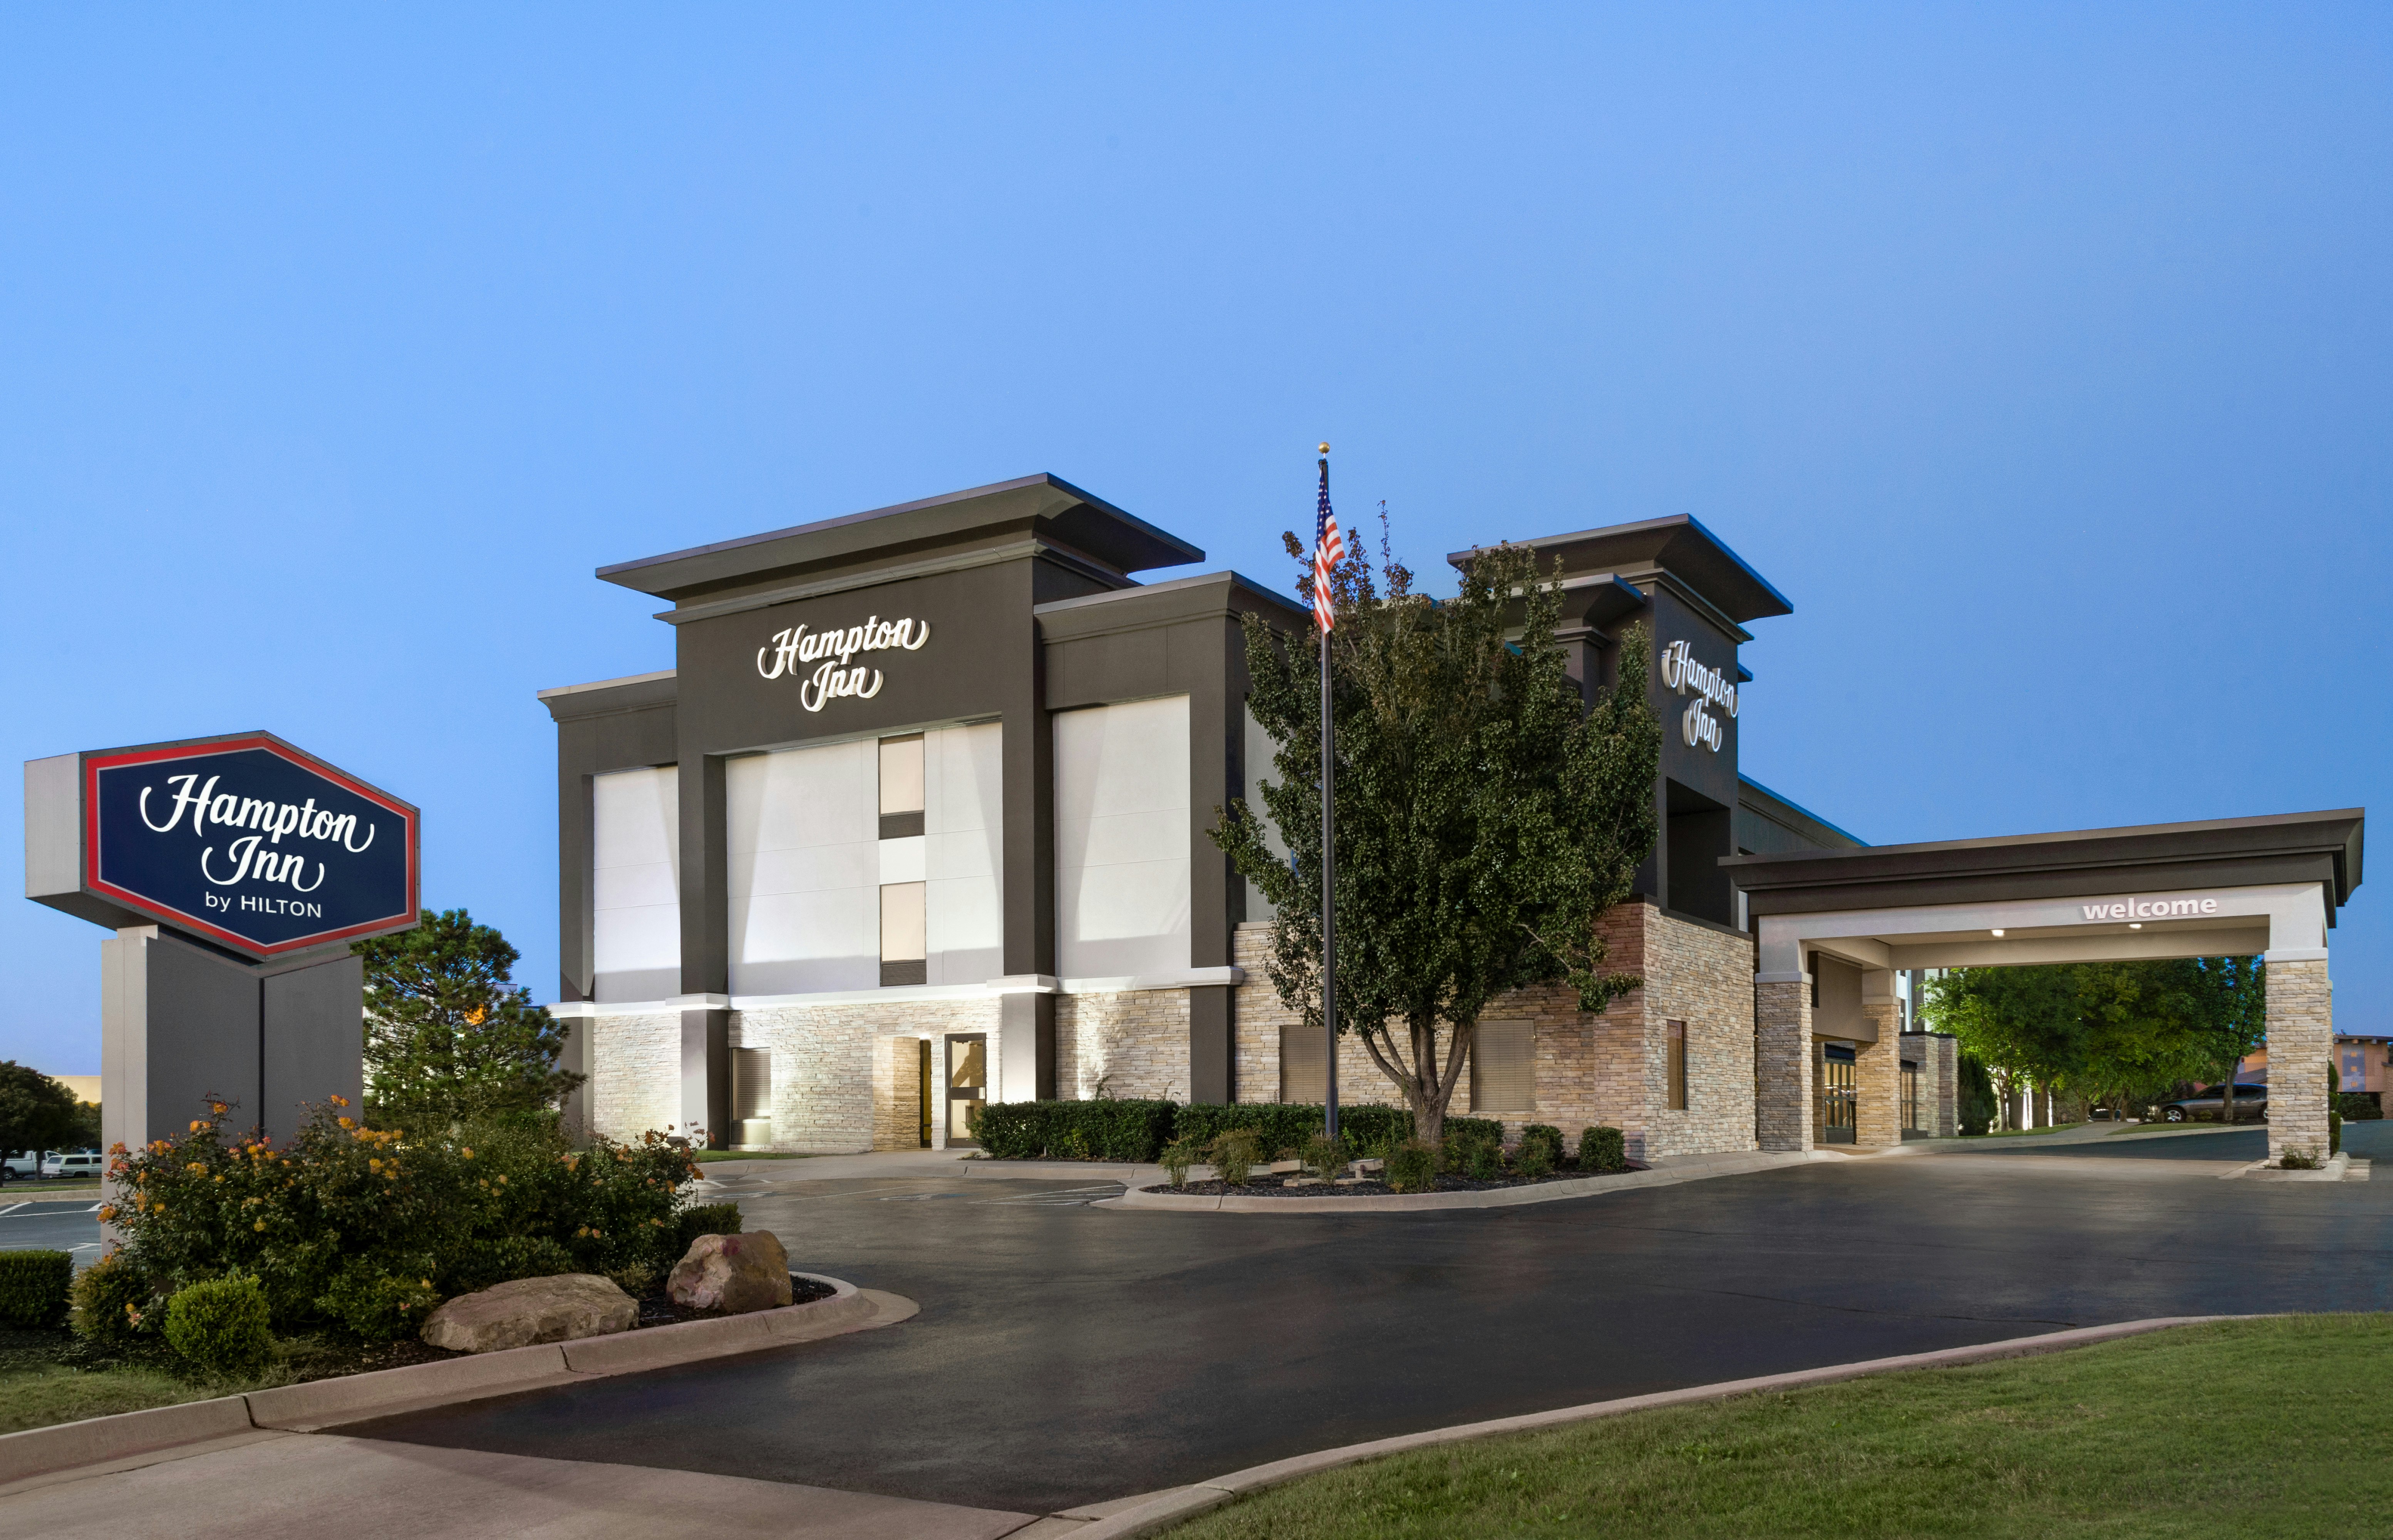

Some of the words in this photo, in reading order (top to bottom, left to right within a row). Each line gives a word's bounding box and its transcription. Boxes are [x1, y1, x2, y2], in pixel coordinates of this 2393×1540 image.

[757, 615, 930, 679] Hampton
[801, 661, 883, 712] Inn
[1661, 640, 1739, 718] Hampton
[1682, 698, 1722, 752] Inn
[139, 774, 375, 853] Hampton
[201, 836, 325, 892] Inn
[205, 891, 231, 912] by
[240, 895, 322, 918] HILTON
[2082, 897, 2217, 920] welcome
